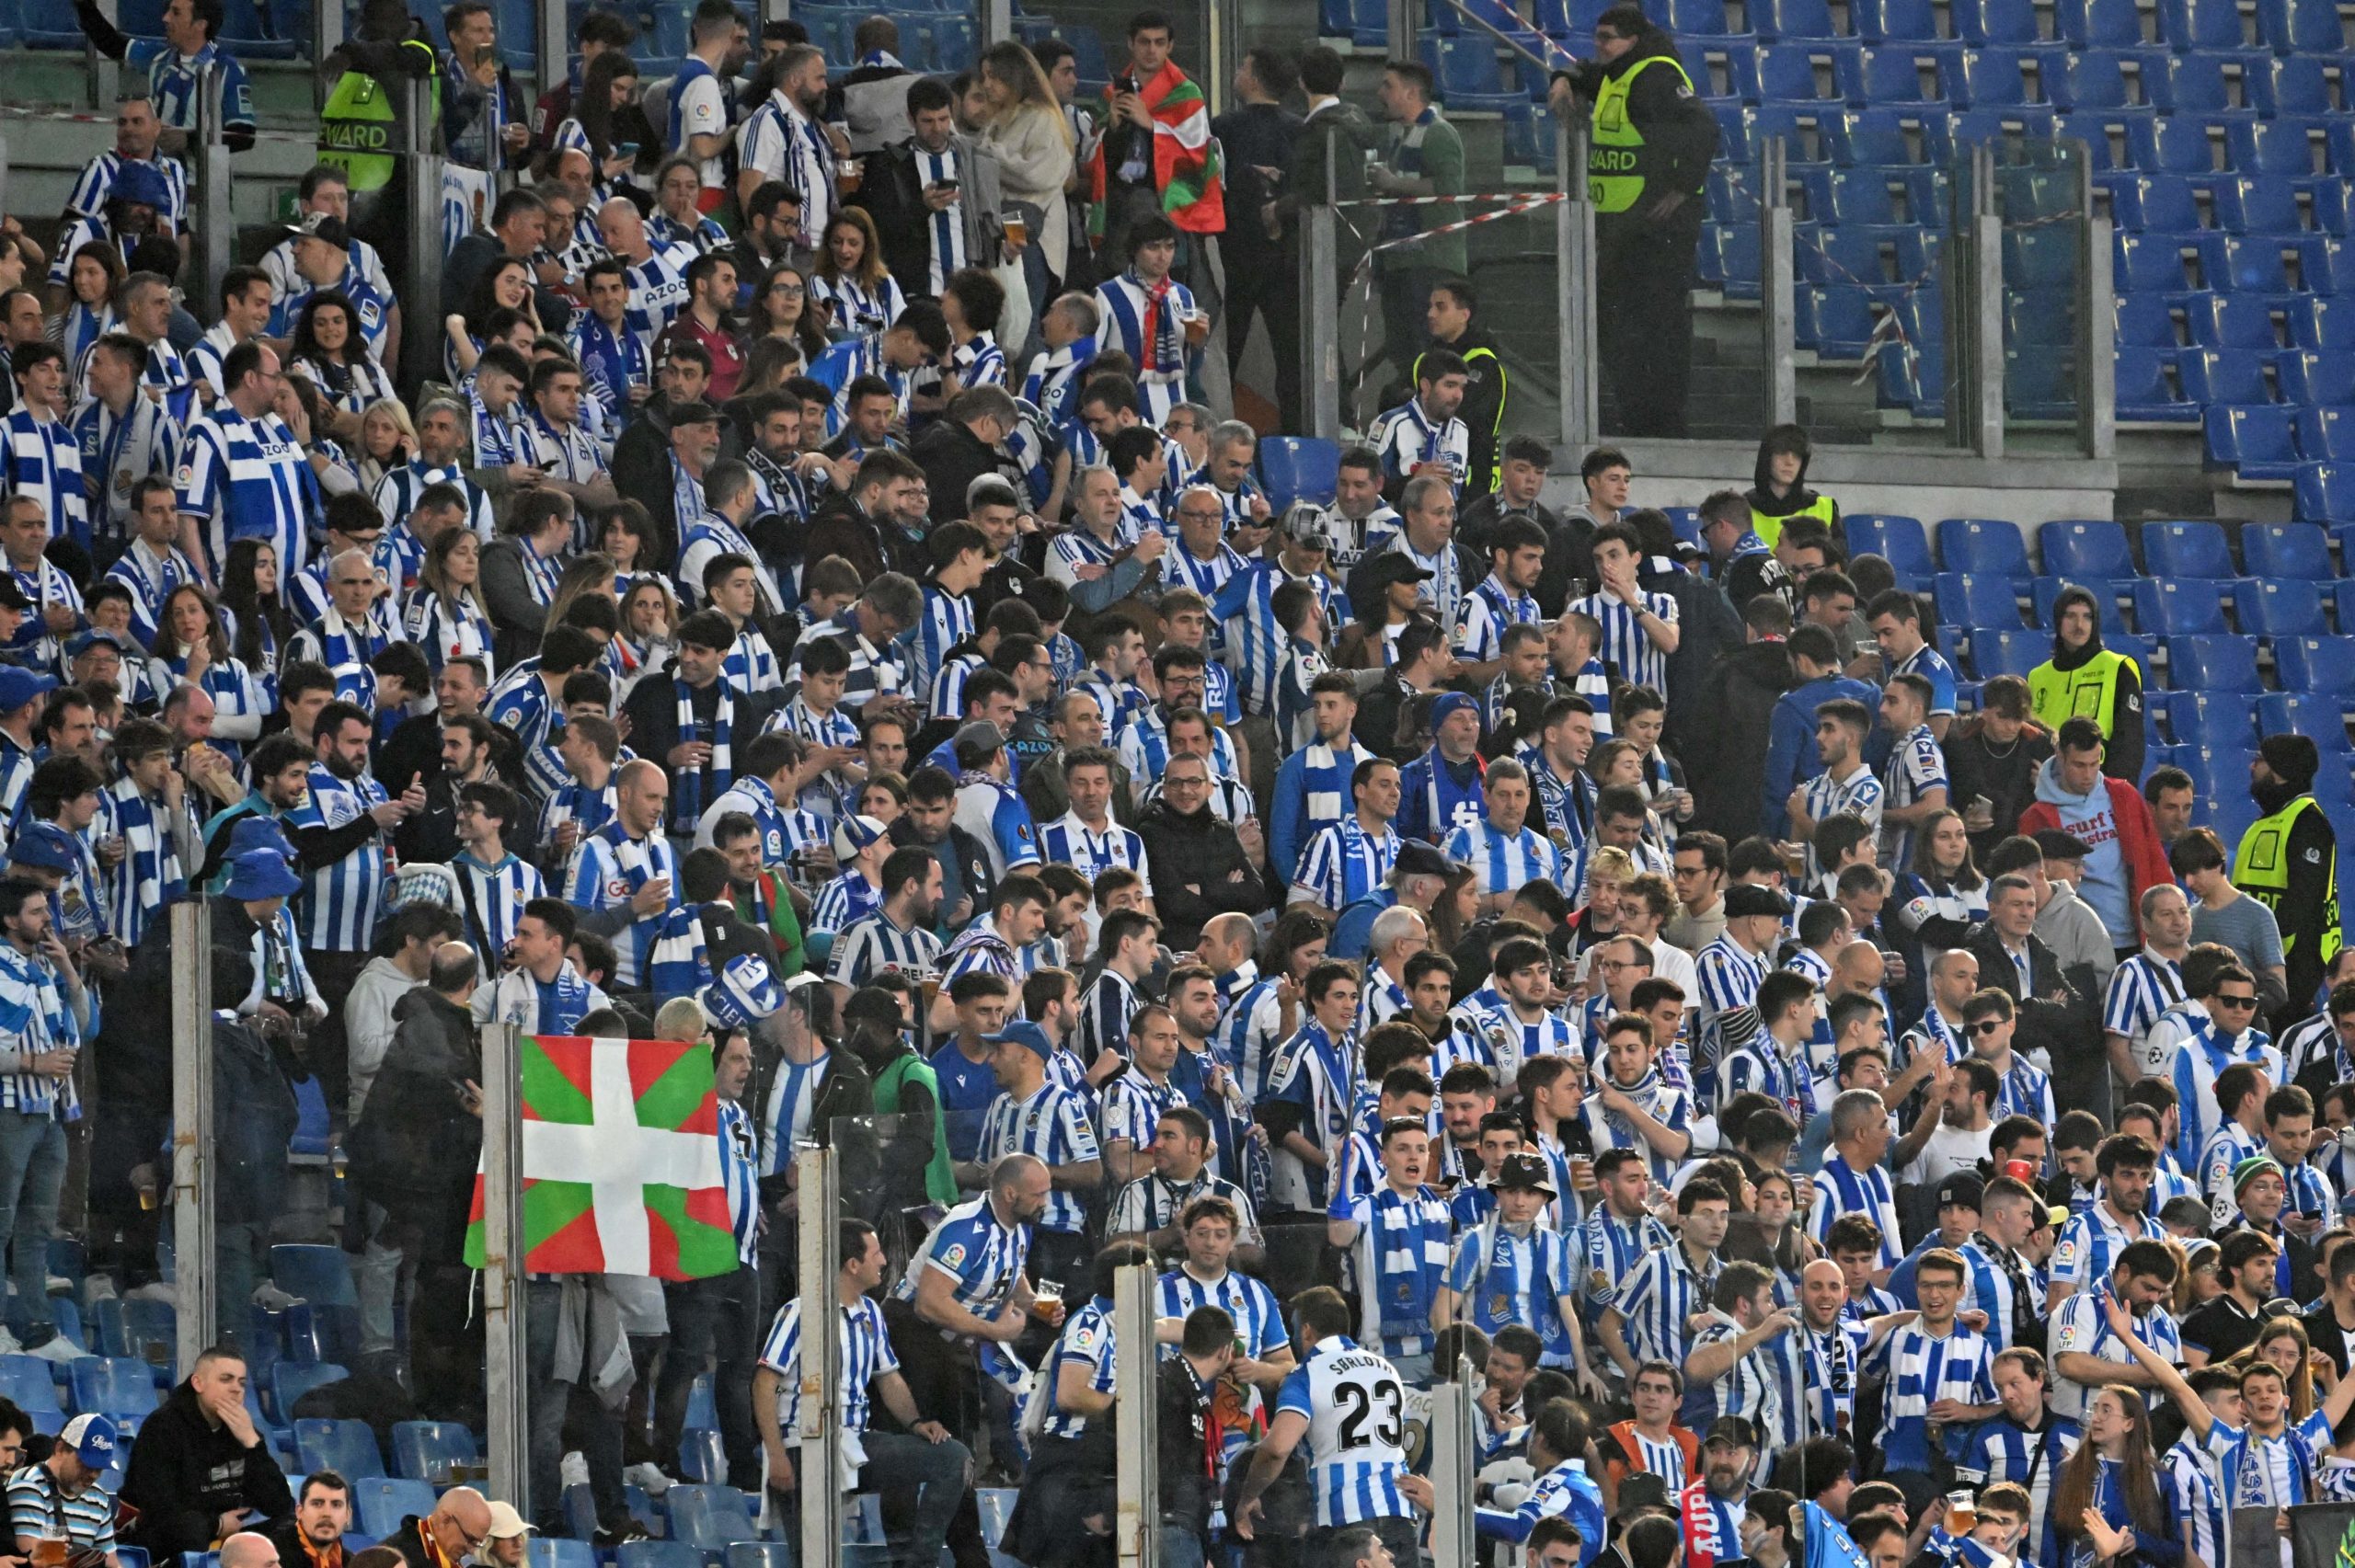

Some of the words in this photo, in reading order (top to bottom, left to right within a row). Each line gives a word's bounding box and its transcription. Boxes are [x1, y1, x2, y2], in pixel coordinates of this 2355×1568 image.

[2065, 816, 2105, 837] surf
[2058, 1340, 2073, 1348] LFP
[1329, 1355, 1394, 1377] SØRLOTH
[1333, 1379, 1403, 1453] 23
